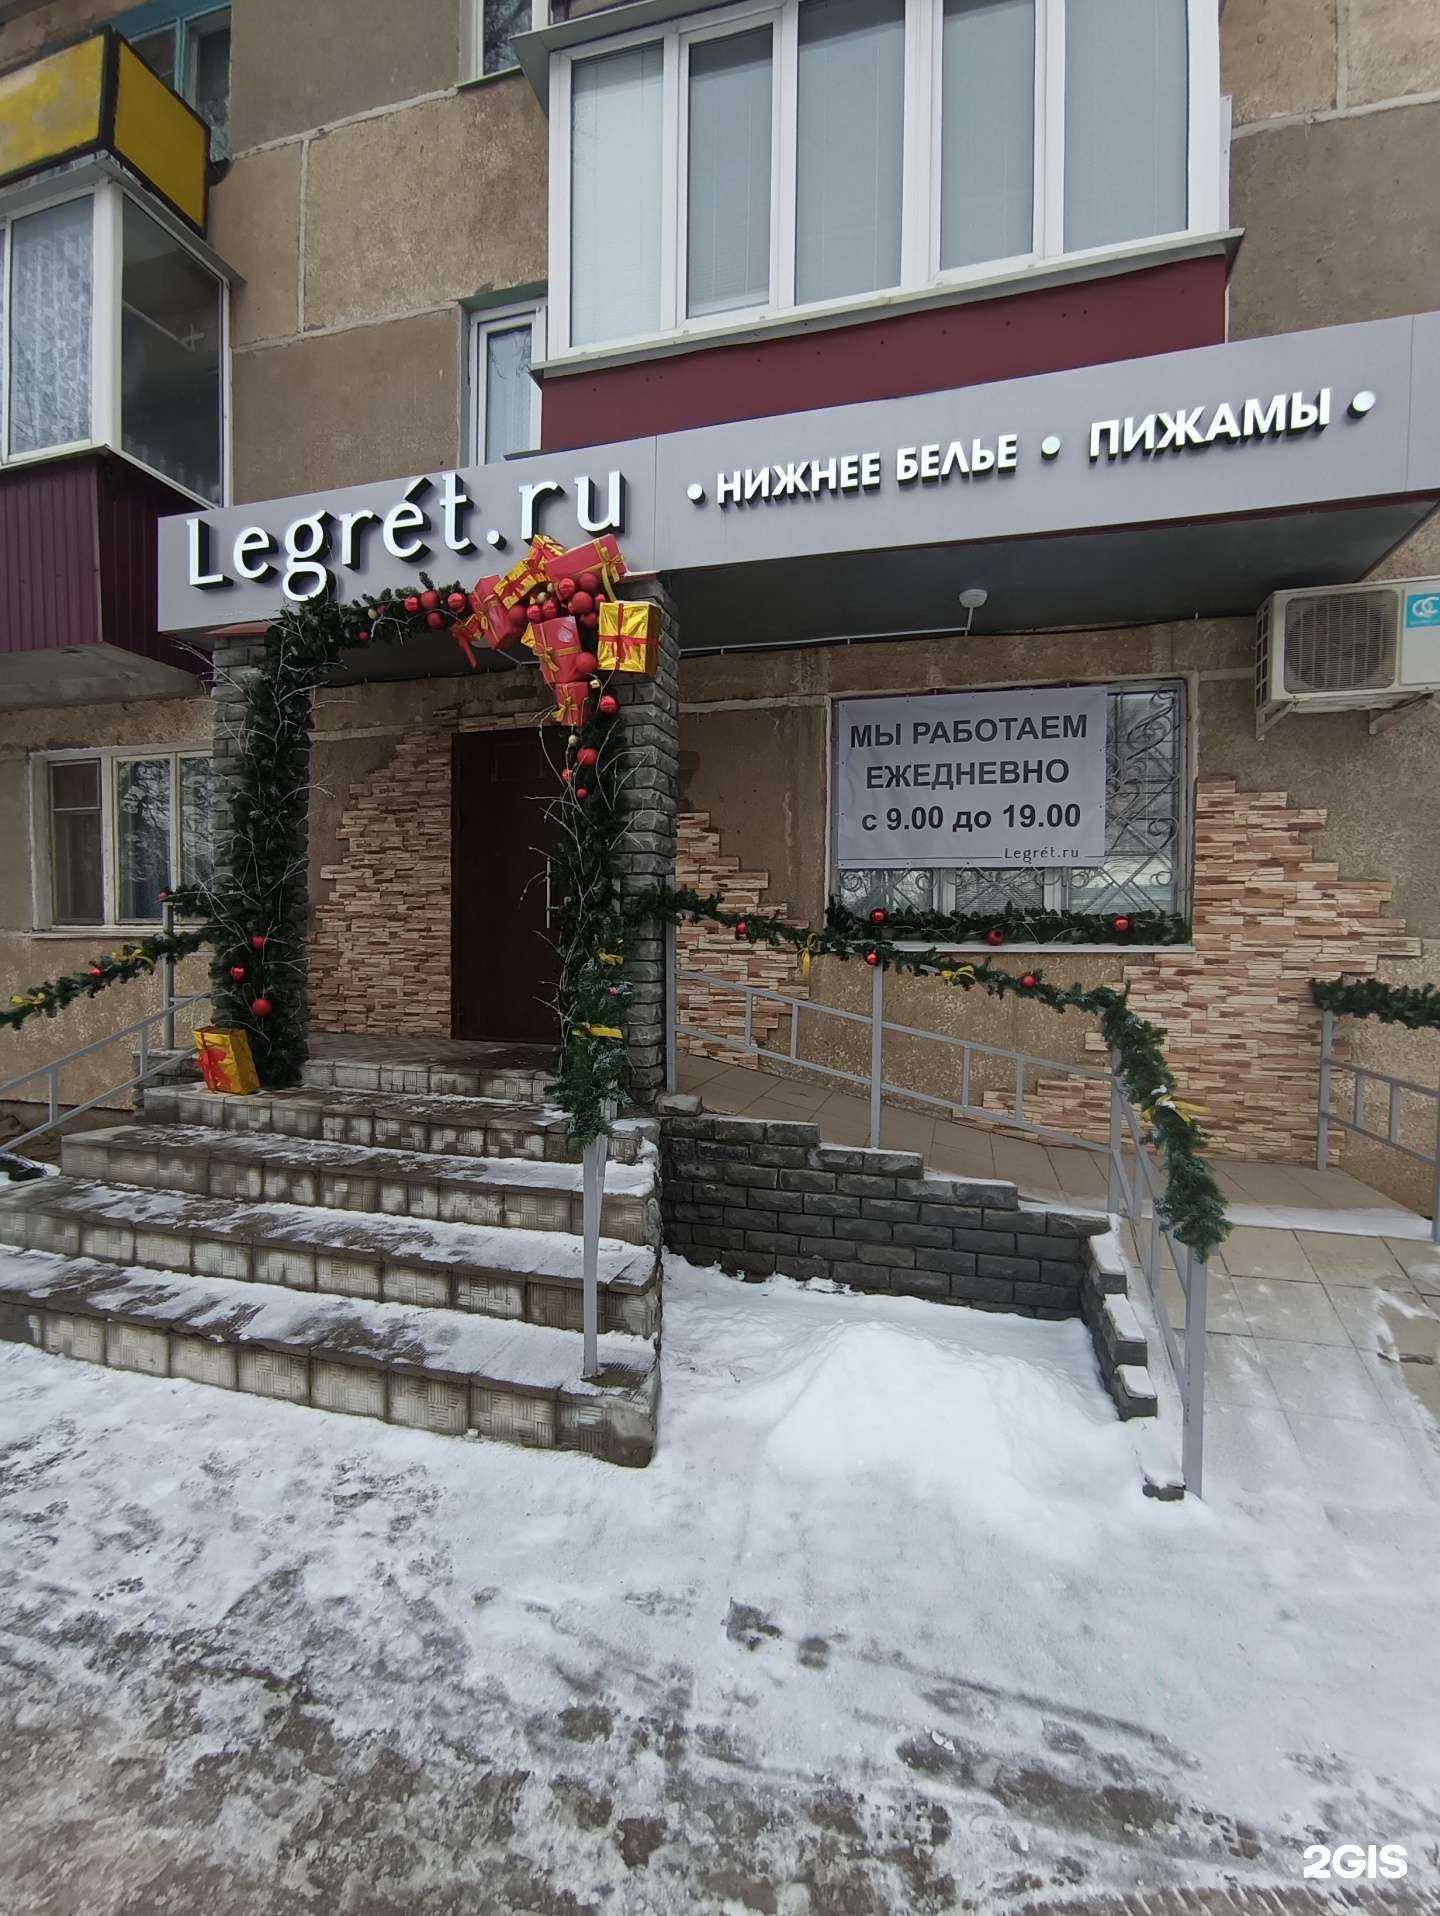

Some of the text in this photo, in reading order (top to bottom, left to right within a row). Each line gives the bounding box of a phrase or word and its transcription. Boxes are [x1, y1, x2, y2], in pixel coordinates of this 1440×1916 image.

[715, 388, 1331, 504] НИЖНЕЕ БЕЛЬЕ ПИЖАМЫ
[185, 471, 623, 601] Legrét.ru
[850, 714, 1088, 748] МЫ РАБОТАЕМ
[865, 759, 1070, 790] ЕЖЕДНЕВНО
[861, 803, 1081, 832] с 9.00 до 19.00
[1004, 846, 1080, 864] Legrét.ru
